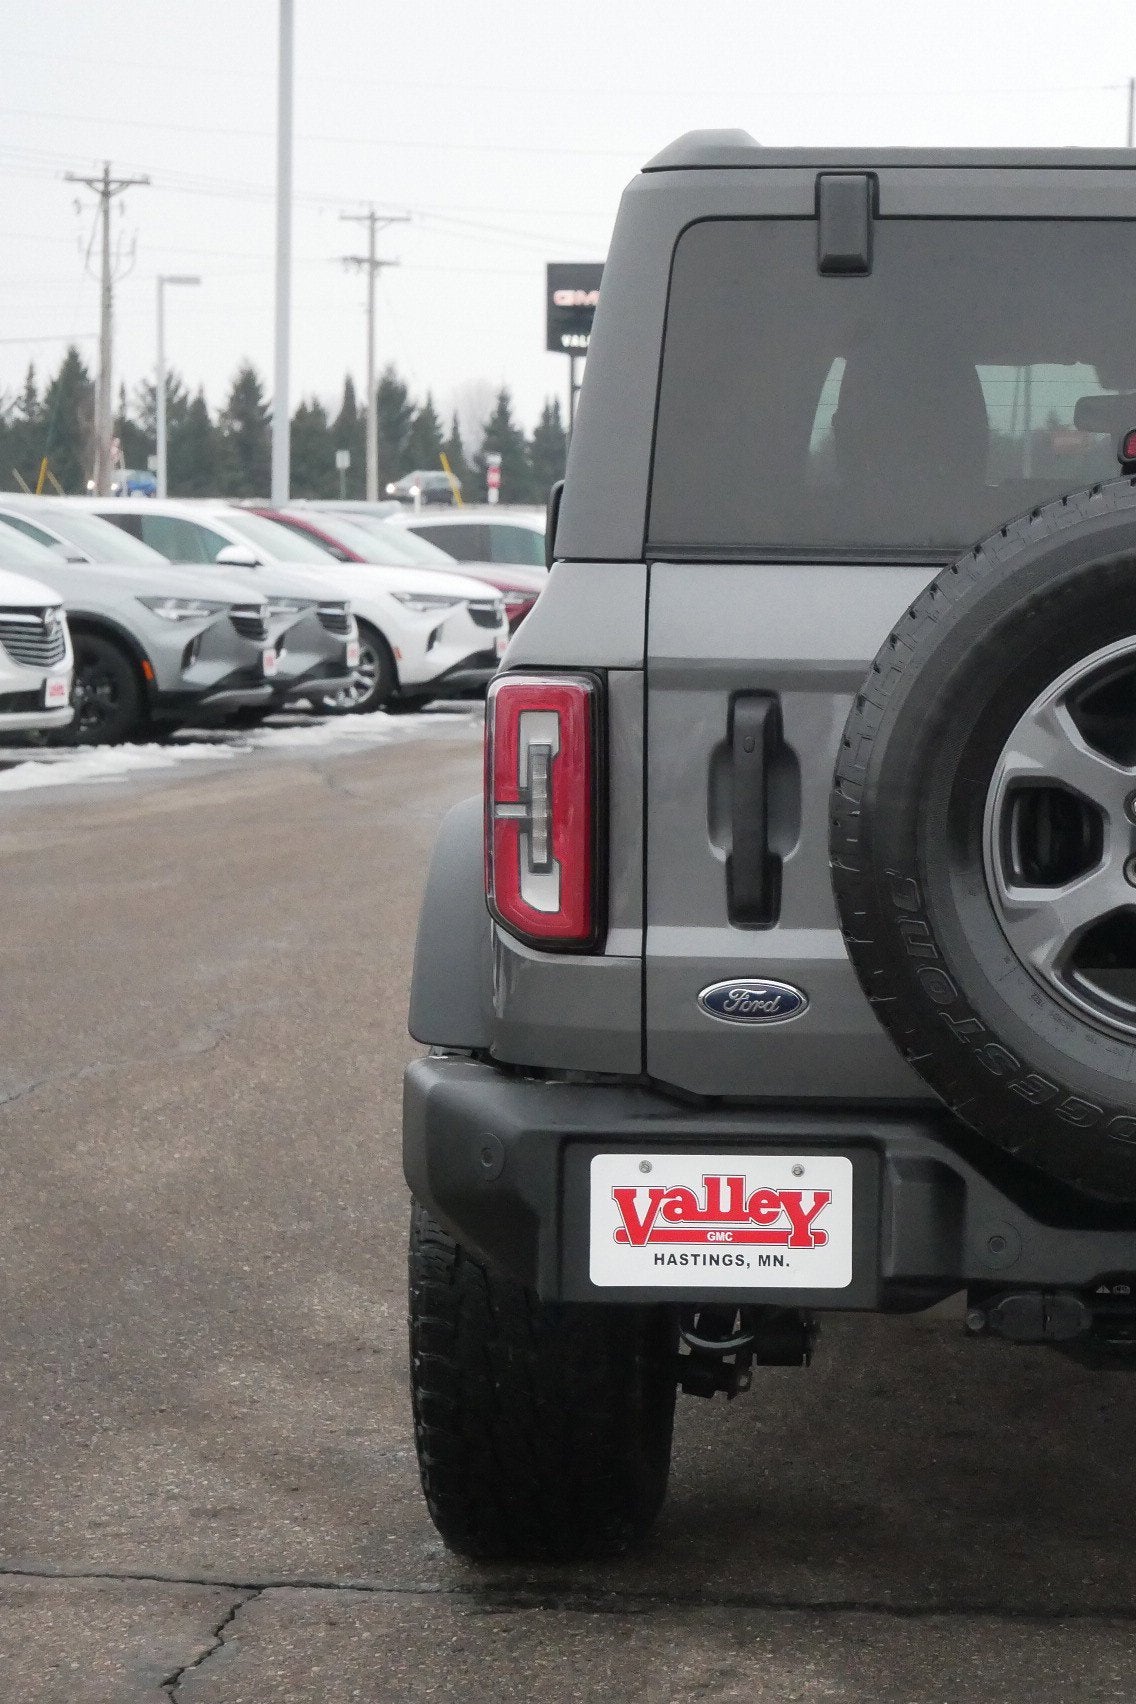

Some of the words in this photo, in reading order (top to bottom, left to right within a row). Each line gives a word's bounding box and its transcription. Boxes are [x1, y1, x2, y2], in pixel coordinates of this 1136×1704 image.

[722, 987, 780, 1013] Ford
[706, 1231, 734, 1243] GMC
[653, 1253, 751, 1269] HASTINGS,
[757, 1254, 791, 1268] MN.
